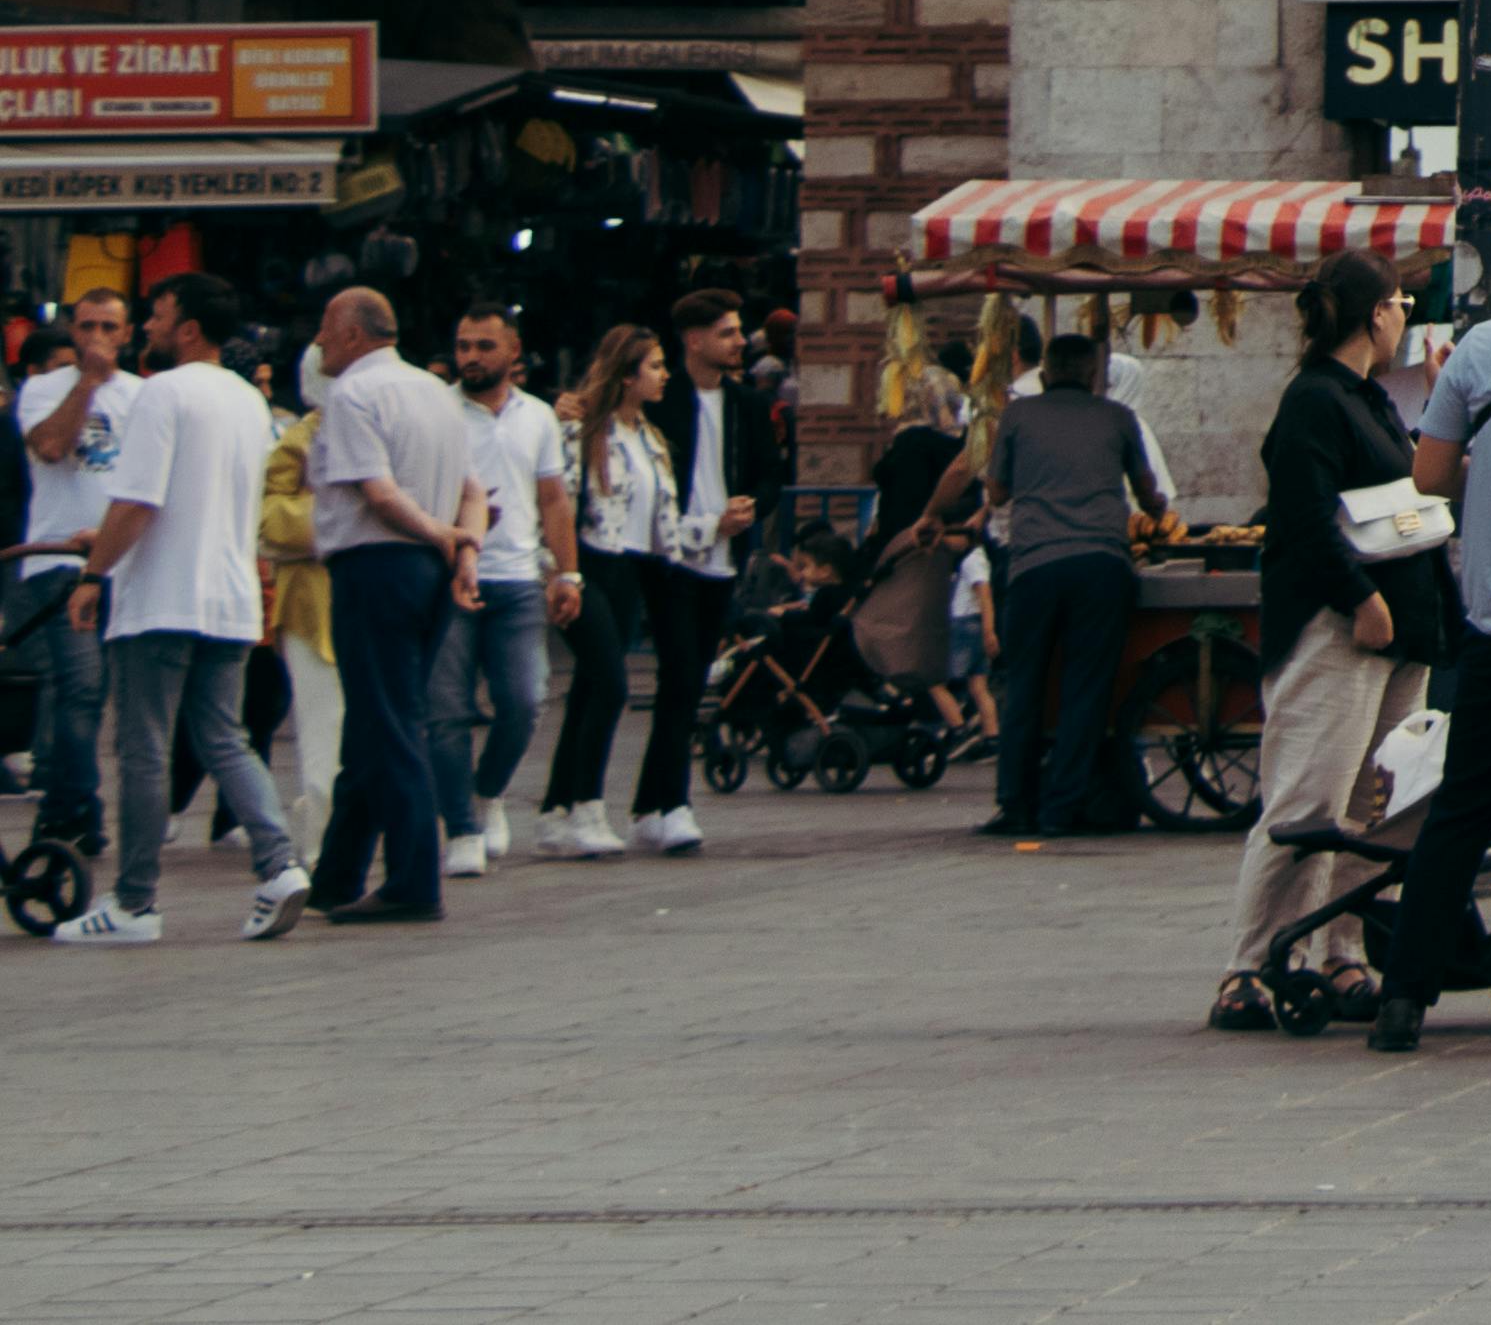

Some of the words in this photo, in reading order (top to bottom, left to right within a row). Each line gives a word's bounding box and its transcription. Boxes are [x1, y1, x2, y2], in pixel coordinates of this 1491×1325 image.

[73, 45, 109, 74] VE
[117, 40, 223, 74] ZİRAAT
[54, 170, 121, 197] KÖPEK
[134, 174, 174, 201] KUŞ
[178, 167, 267, 196] YEMLERİ
[309, 171, 323, 194] 2
